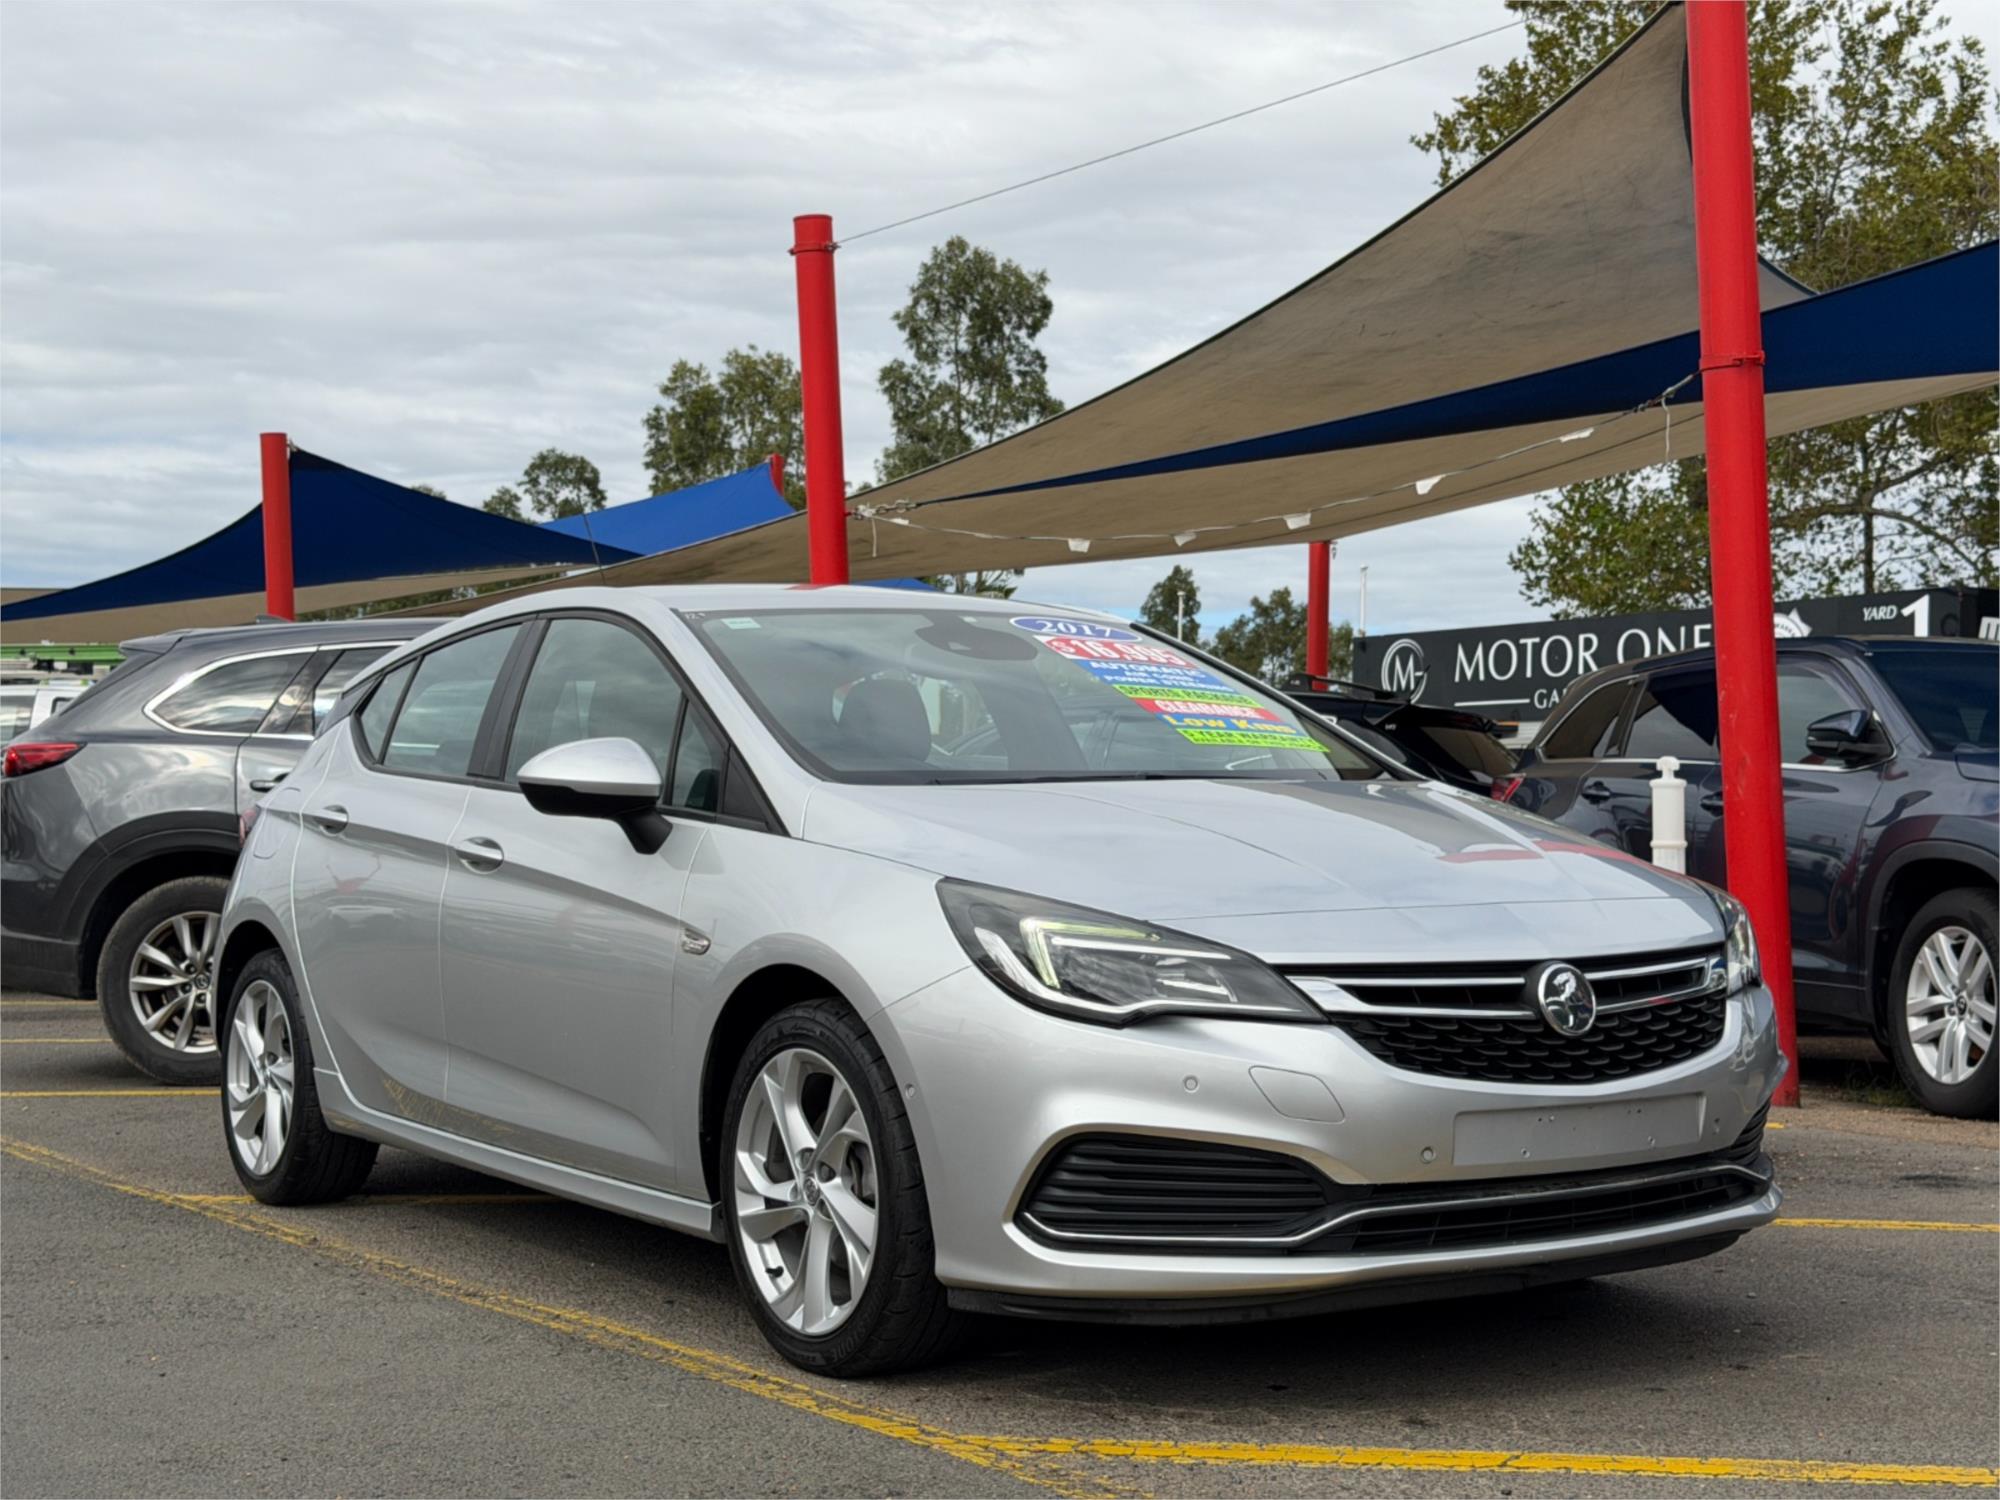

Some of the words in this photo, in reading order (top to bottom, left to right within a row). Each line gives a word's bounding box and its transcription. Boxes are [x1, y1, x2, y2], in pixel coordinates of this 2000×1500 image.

[1036, 620, 1113, 638] 2017
[1862, 605, 1898, 621] YARD
[1901, 593, 1930, 637] 1
[1454, 631, 1599, 683] MOTOR
[1616, 624, 1713, 664] ONE
[1154, 699, 1265, 720] CLEARANCE
